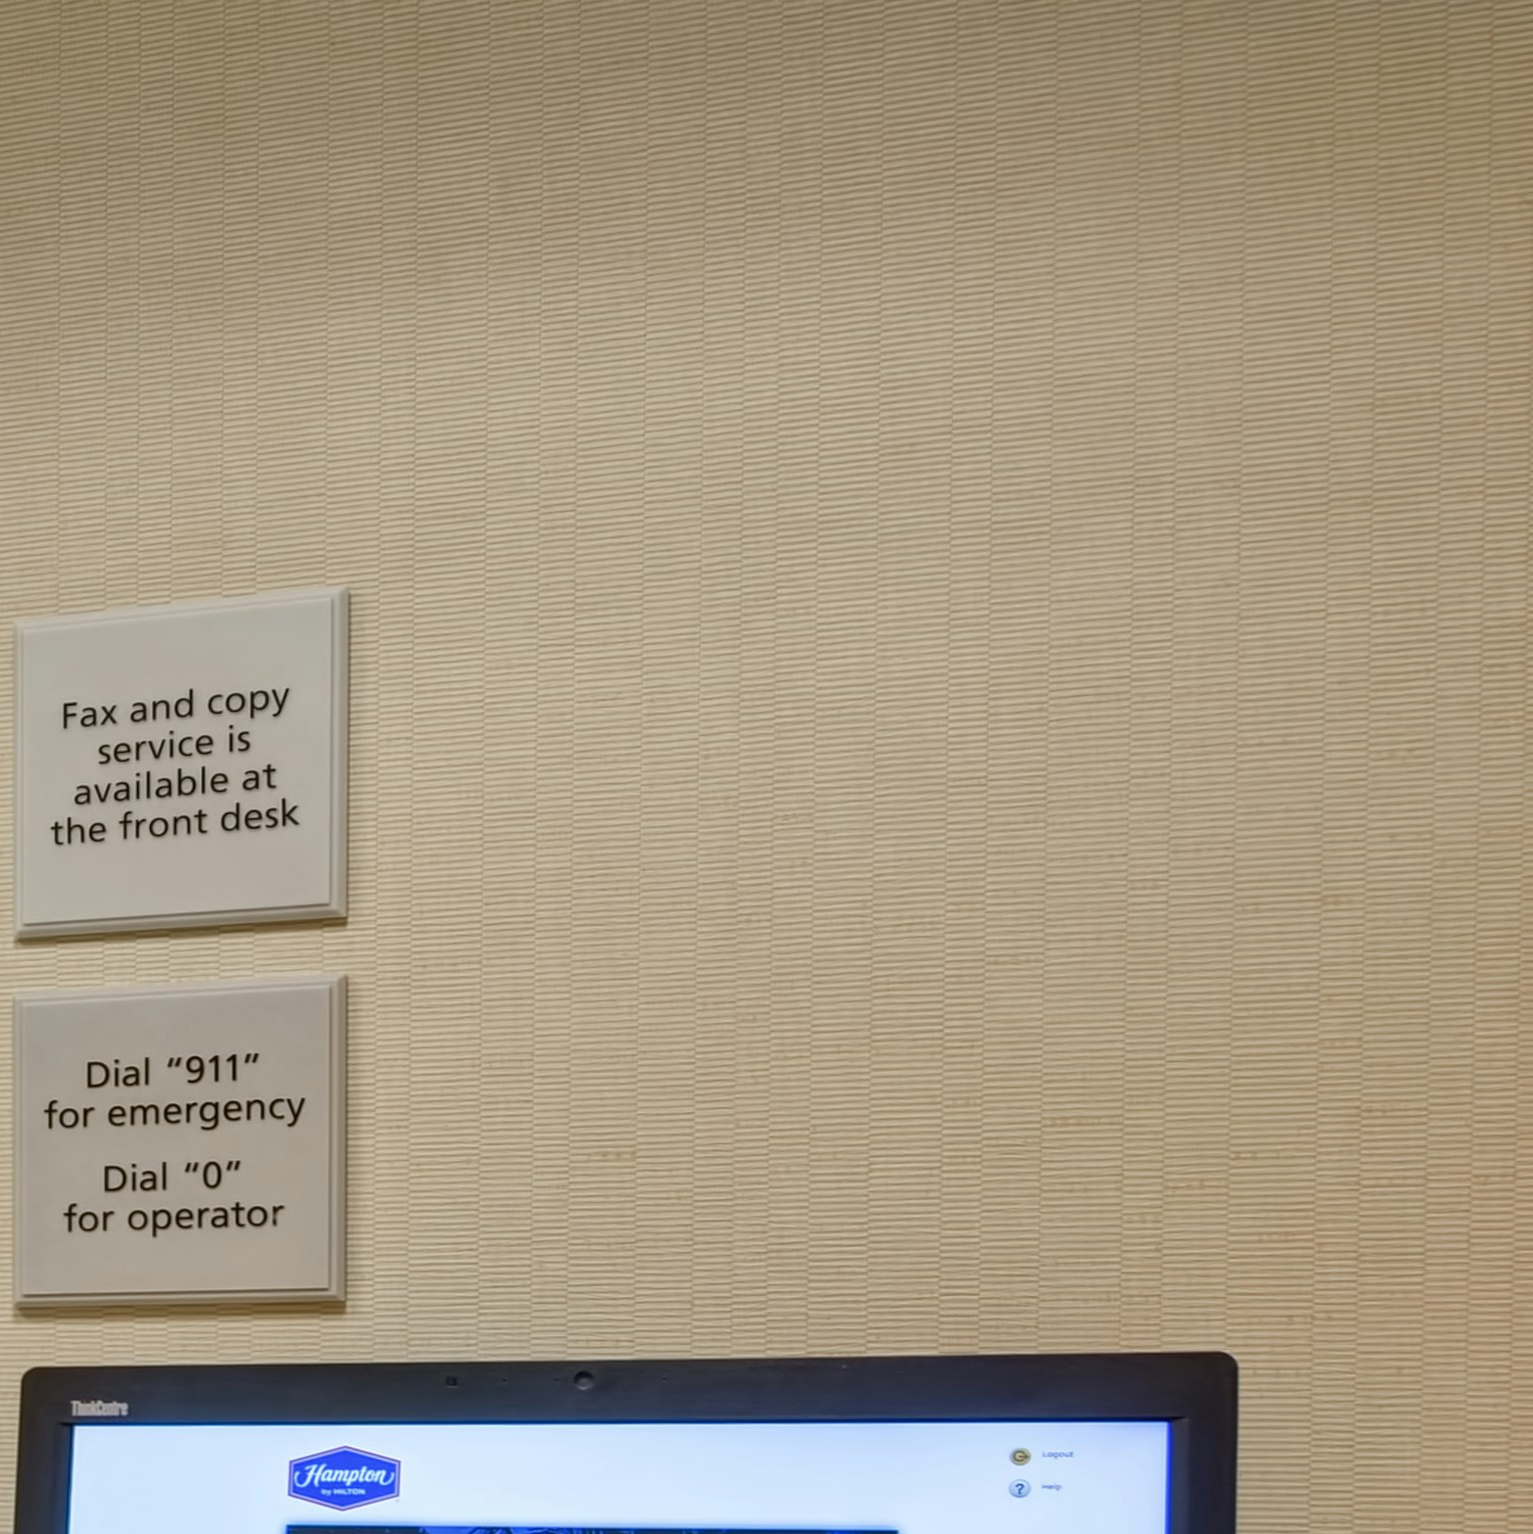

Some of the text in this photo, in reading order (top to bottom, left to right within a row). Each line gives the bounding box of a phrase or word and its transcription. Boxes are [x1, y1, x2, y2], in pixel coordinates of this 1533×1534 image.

[63, 687, 290, 729] Fax and copy
[98, 725, 251, 765] service is
[74, 764, 277, 805] available at
[51, 798, 300, 845] the front desk
[86, 1053, 260, 1088] Dial “911”
[43, 1096, 306, 1131] for emergency
[103, 1161, 167, 1192] Dial
[63, 1202, 285, 1238] for operator
[71, 1400, 129, 1416] ThinkCentre
[1042, 1451, 1074, 1459] Logout
[294, 1463, 395, 1489] Hampton
[320, 1488, 331, 1496] by
